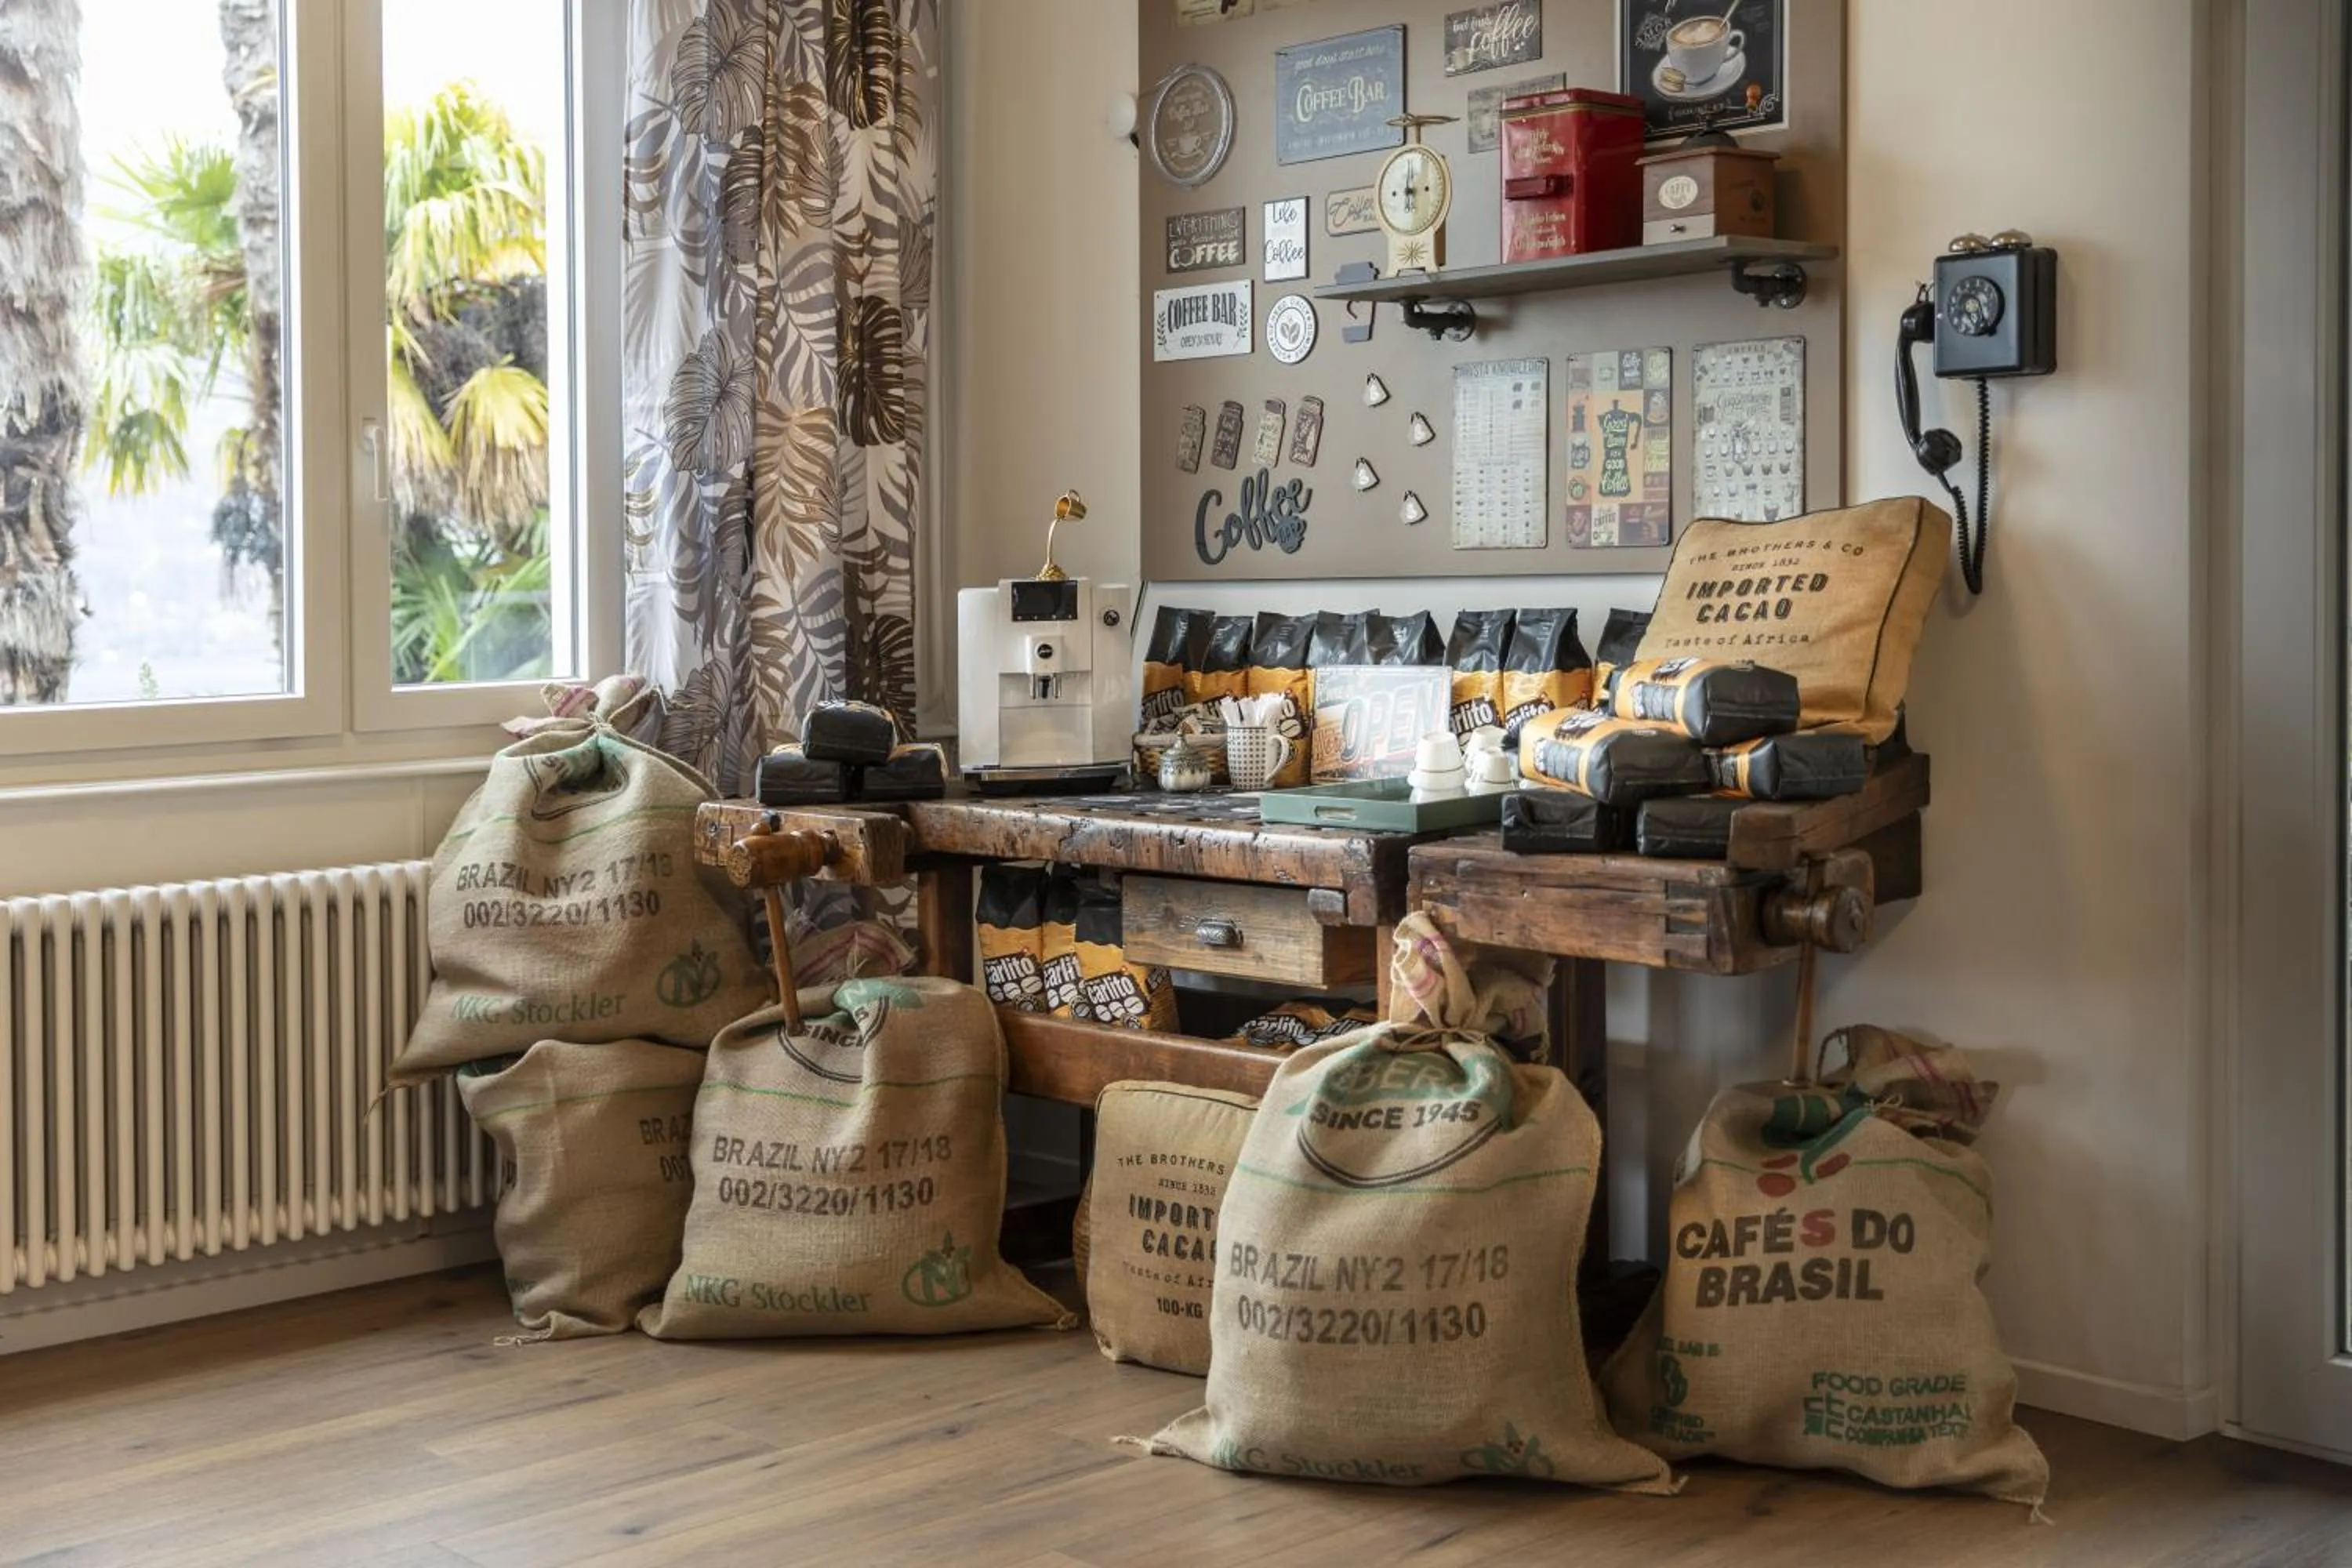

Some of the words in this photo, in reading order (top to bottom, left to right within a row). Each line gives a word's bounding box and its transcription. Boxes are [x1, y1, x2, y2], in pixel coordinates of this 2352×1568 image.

[1470, 2, 1537, 59] coffee
[1169, 241, 1240, 268] COFFEE
[1167, 294, 1208, 333] COFFEE
[1211, 292, 1237, 327] BAR
[1195, 468, 1313, 565] Coffee
[1690, 551, 1718, 565] THE
[1727, 540, 1816, 558] BROTHERS
[1842, 542, 1864, 557] CO
[1686, 573, 1830, 601] IMPORTED
[1696, 597, 1793, 625] CACAO
[1717, 634, 1738, 646] of
[1742, 633, 1811, 646] Africa
[1341, 682, 1444, 764] OPEN
[456, 861, 539, 897] BRAZIL
[463, 889, 660, 929] 002/3220/1130
[451, 993, 504, 1024] NKG
[511, 991, 627, 1026] Stockler
[1087, 976, 1135, 1004] carlito
[640, 1111, 692, 1145] BRAZ
[1310, 1101, 1405, 1131] SINCE
[1412, 1100, 1482, 1128] 1945
[712, 1134, 804, 1174] BRAZIL
[1118, 1152, 1142, 1168] THE
[1149, 1152, 1225, 1177] BROTHERS
[717, 1175, 935, 1218] 002/3220/1130
[1129, 1193, 1215, 1232] IMPORT
[1676, 1208, 1836, 1260] CAFÉS
[1852, 1208, 1915, 1254] DO
[1188, 1274, 1214, 1289] Afr
[1229, 1240, 1327, 1293] BRAZIL
[1418, 1243, 1509, 1284] 17/18
[1695, 1257, 1885, 1308] BRASIL
[684, 1273, 740, 1308] NKG
[751, 1281, 873, 1316] Stockler
[1238, 1294, 1486, 1345] 002/3220/1130
[1812, 1372, 1882, 1396] FOOD
[1889, 1374, 1967, 1398] GRADE
